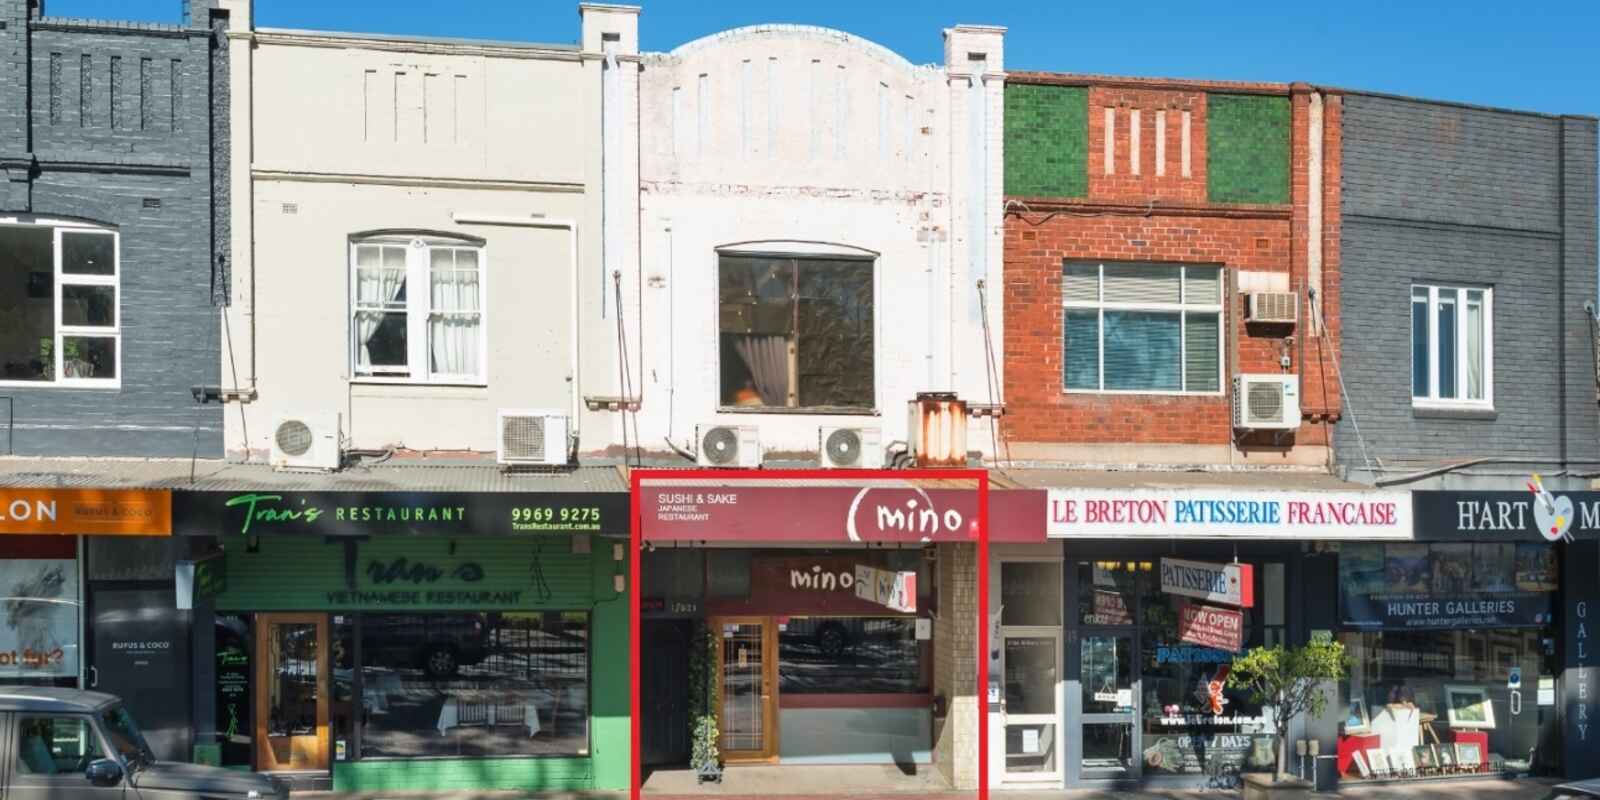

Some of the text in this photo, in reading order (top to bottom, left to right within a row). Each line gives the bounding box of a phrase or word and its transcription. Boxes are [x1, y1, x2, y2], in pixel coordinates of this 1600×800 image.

[658, 493, 737, 504] SUSHI & SAKE
[225, 494, 465, 534] Tran's RESTAURANT
[512, 508, 600, 521] 9969 9275
[658, 513, 709, 521] RESTAURANT
[877, 499, 962, 535] mino
[1053, 501, 1077, 523] LE
[1084, 501, 1168, 523] BRETON
[1175, 502, 1280, 524] PATISSERIE
[1456, 501, 1529, 531] H'ART
[791, 565, 854, 591] mino
[1162, 562, 1227, 594] PATISSERIE
[1387, 601, 1516, 616] HUNTER GALLERIES
[1209, 612, 1239, 631] OPEN
[1577, 601, 1588, 740] GALLERY
[1221, 735, 1252, 748] DAYS
